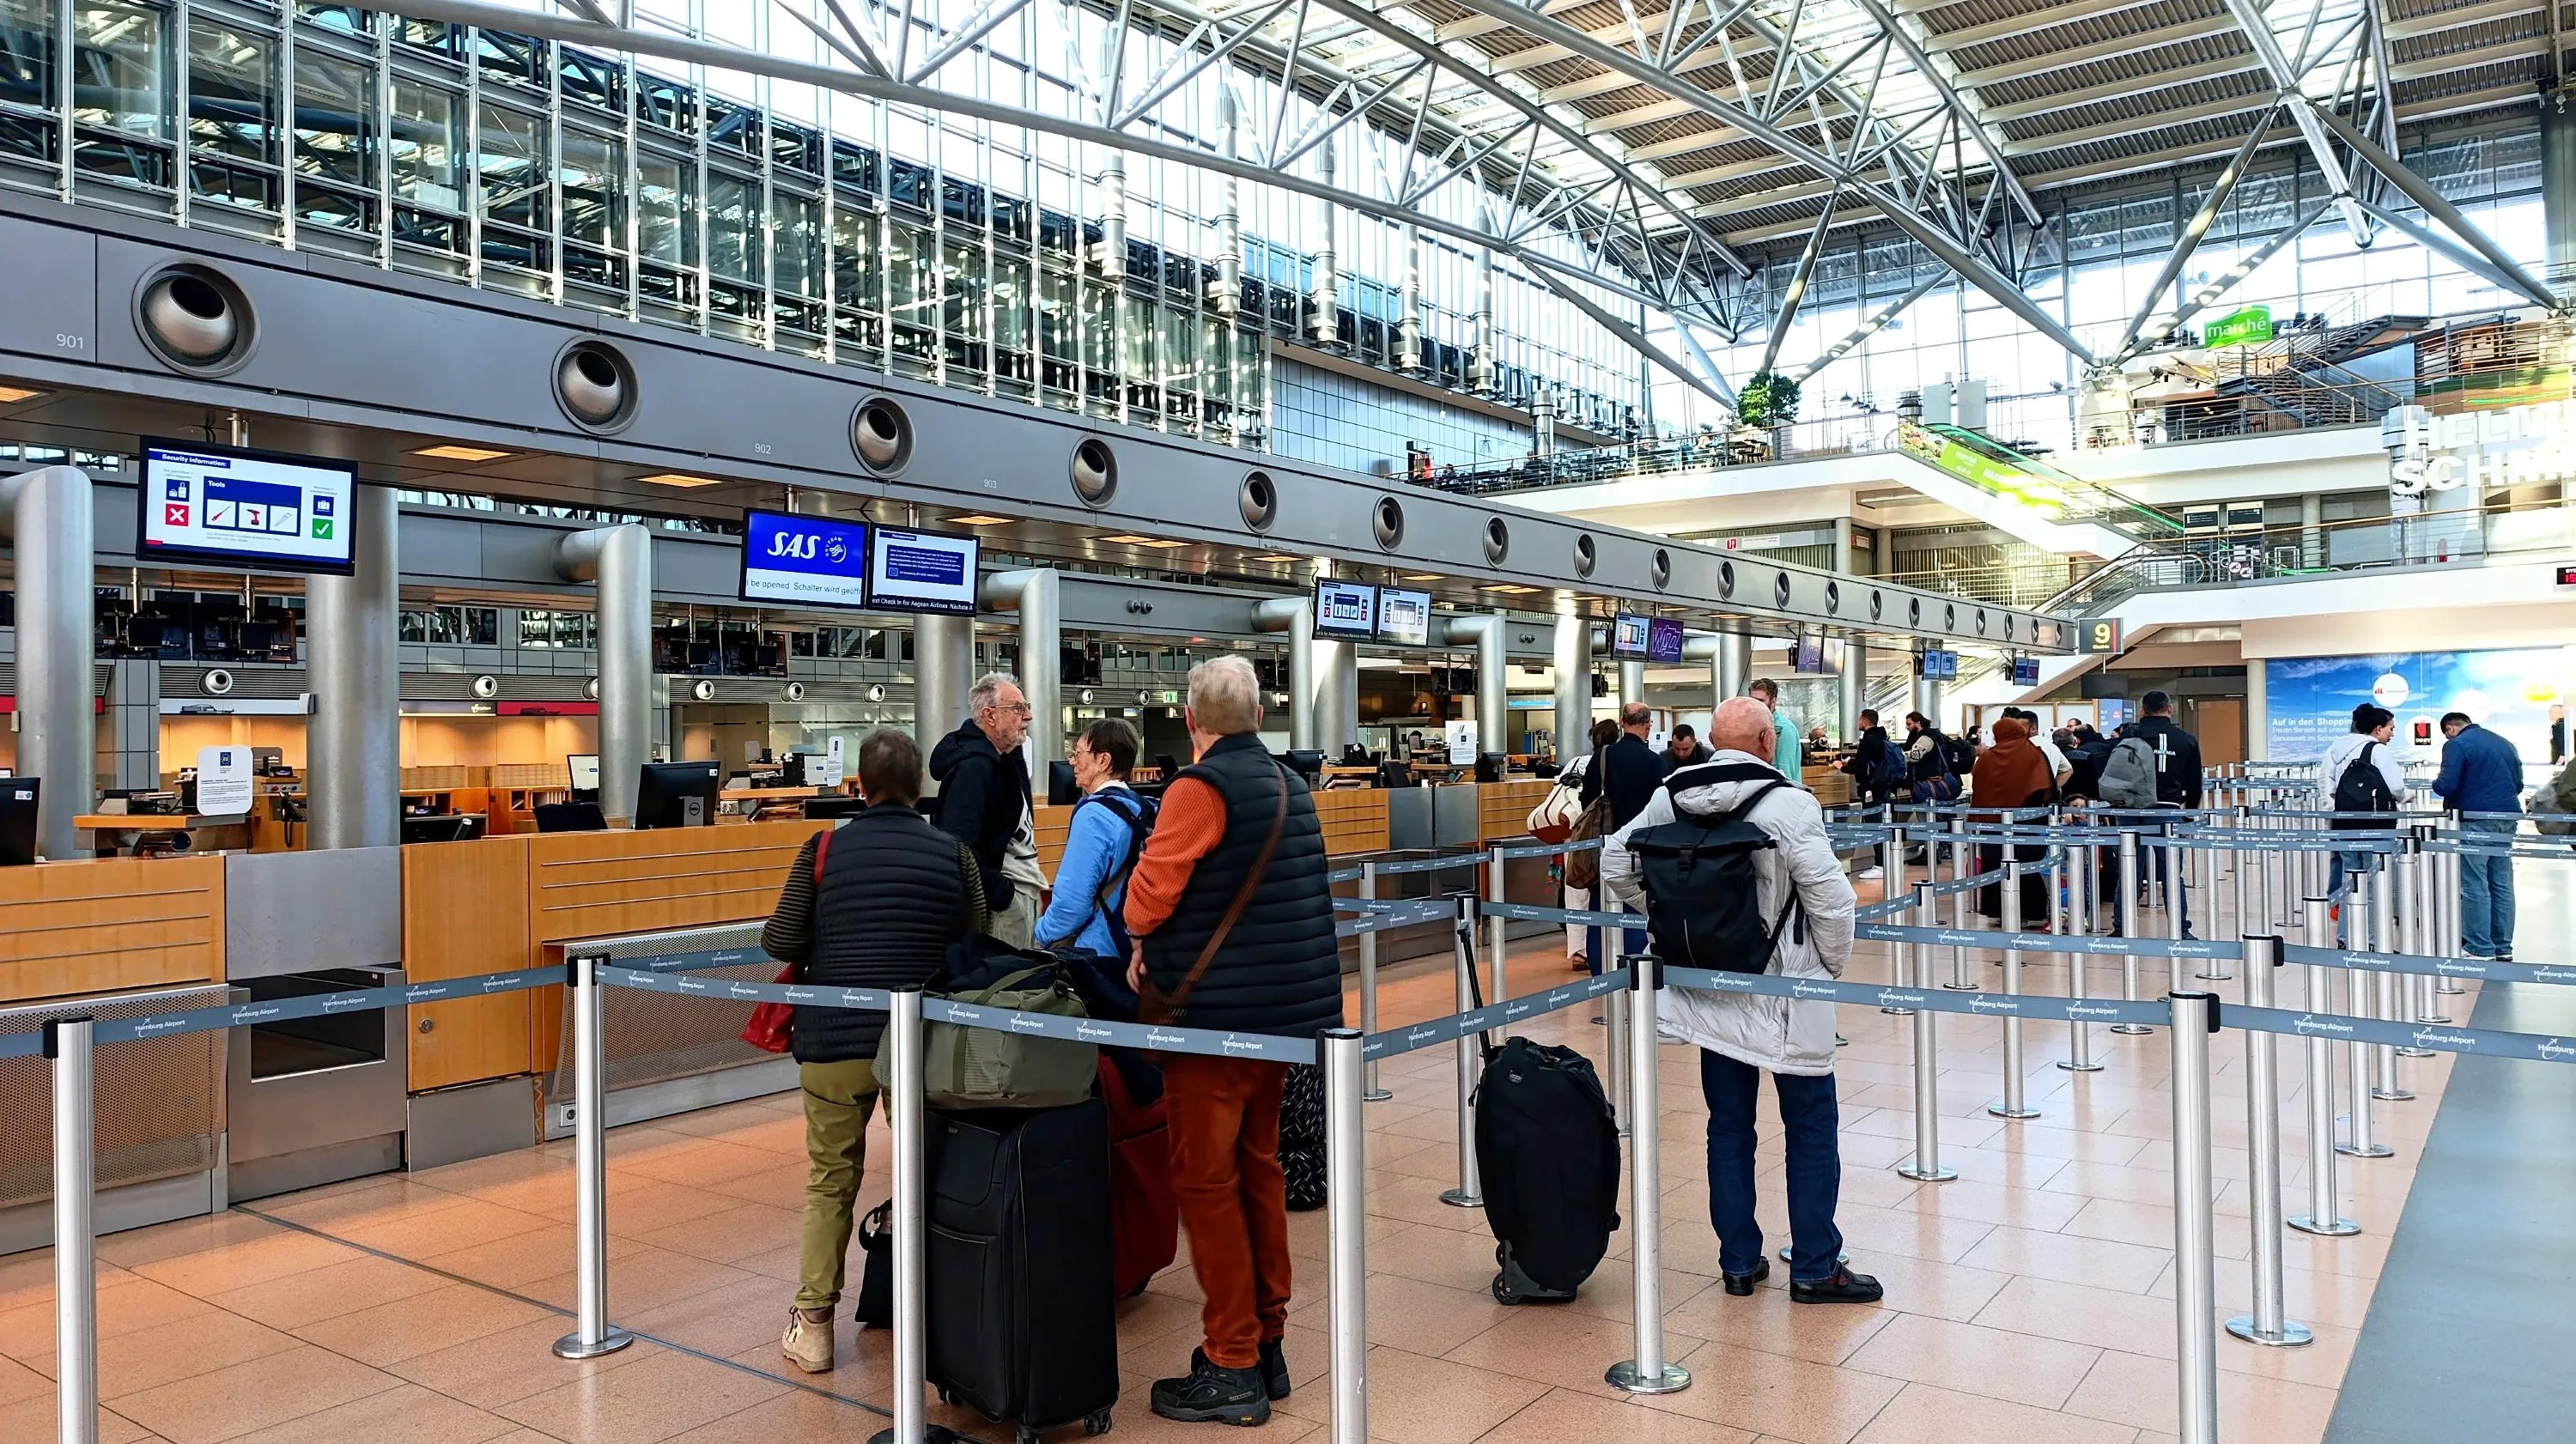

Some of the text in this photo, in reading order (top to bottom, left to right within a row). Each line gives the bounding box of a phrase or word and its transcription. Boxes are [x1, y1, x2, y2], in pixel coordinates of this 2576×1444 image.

[2208, 315, 2267, 338] marché
[56, 334, 84, 349] 901
[2405, 398, 2576, 453] HELM
[755, 443, 771, 454] 902
[162, 454, 228, 467] Security information:
[983, 478, 997, 488] 903
[767, 531, 821, 559] SAS
[762, 580, 790, 589] opened
[793, 582, 823, 592] Schalter
[2095, 623, 2111, 644] 9
[2272, 718, 2353, 727] Auf in den Shoppin
[1793, 985, 1817, 993] Hamburg
[1878, 992, 1904, 1001] Hamburg
[1969, 999, 2018, 1010] Hamburg Airport
[965, 1010, 980, 1019] Airport
[1010, 1018, 1029, 1027] Hamburg
[2294, 1020, 2354, 1032] Hamburg Airport
[1076, 1026, 1096, 1034] Hamburg
[1146, 1034, 1168, 1042] Hamburg
[2413, 1032, 2476, 1045] Hamburg Airport
[1222, 1040, 1245, 1049] Hamburg
[2538, 1044, 2574, 1054] Hamburg
